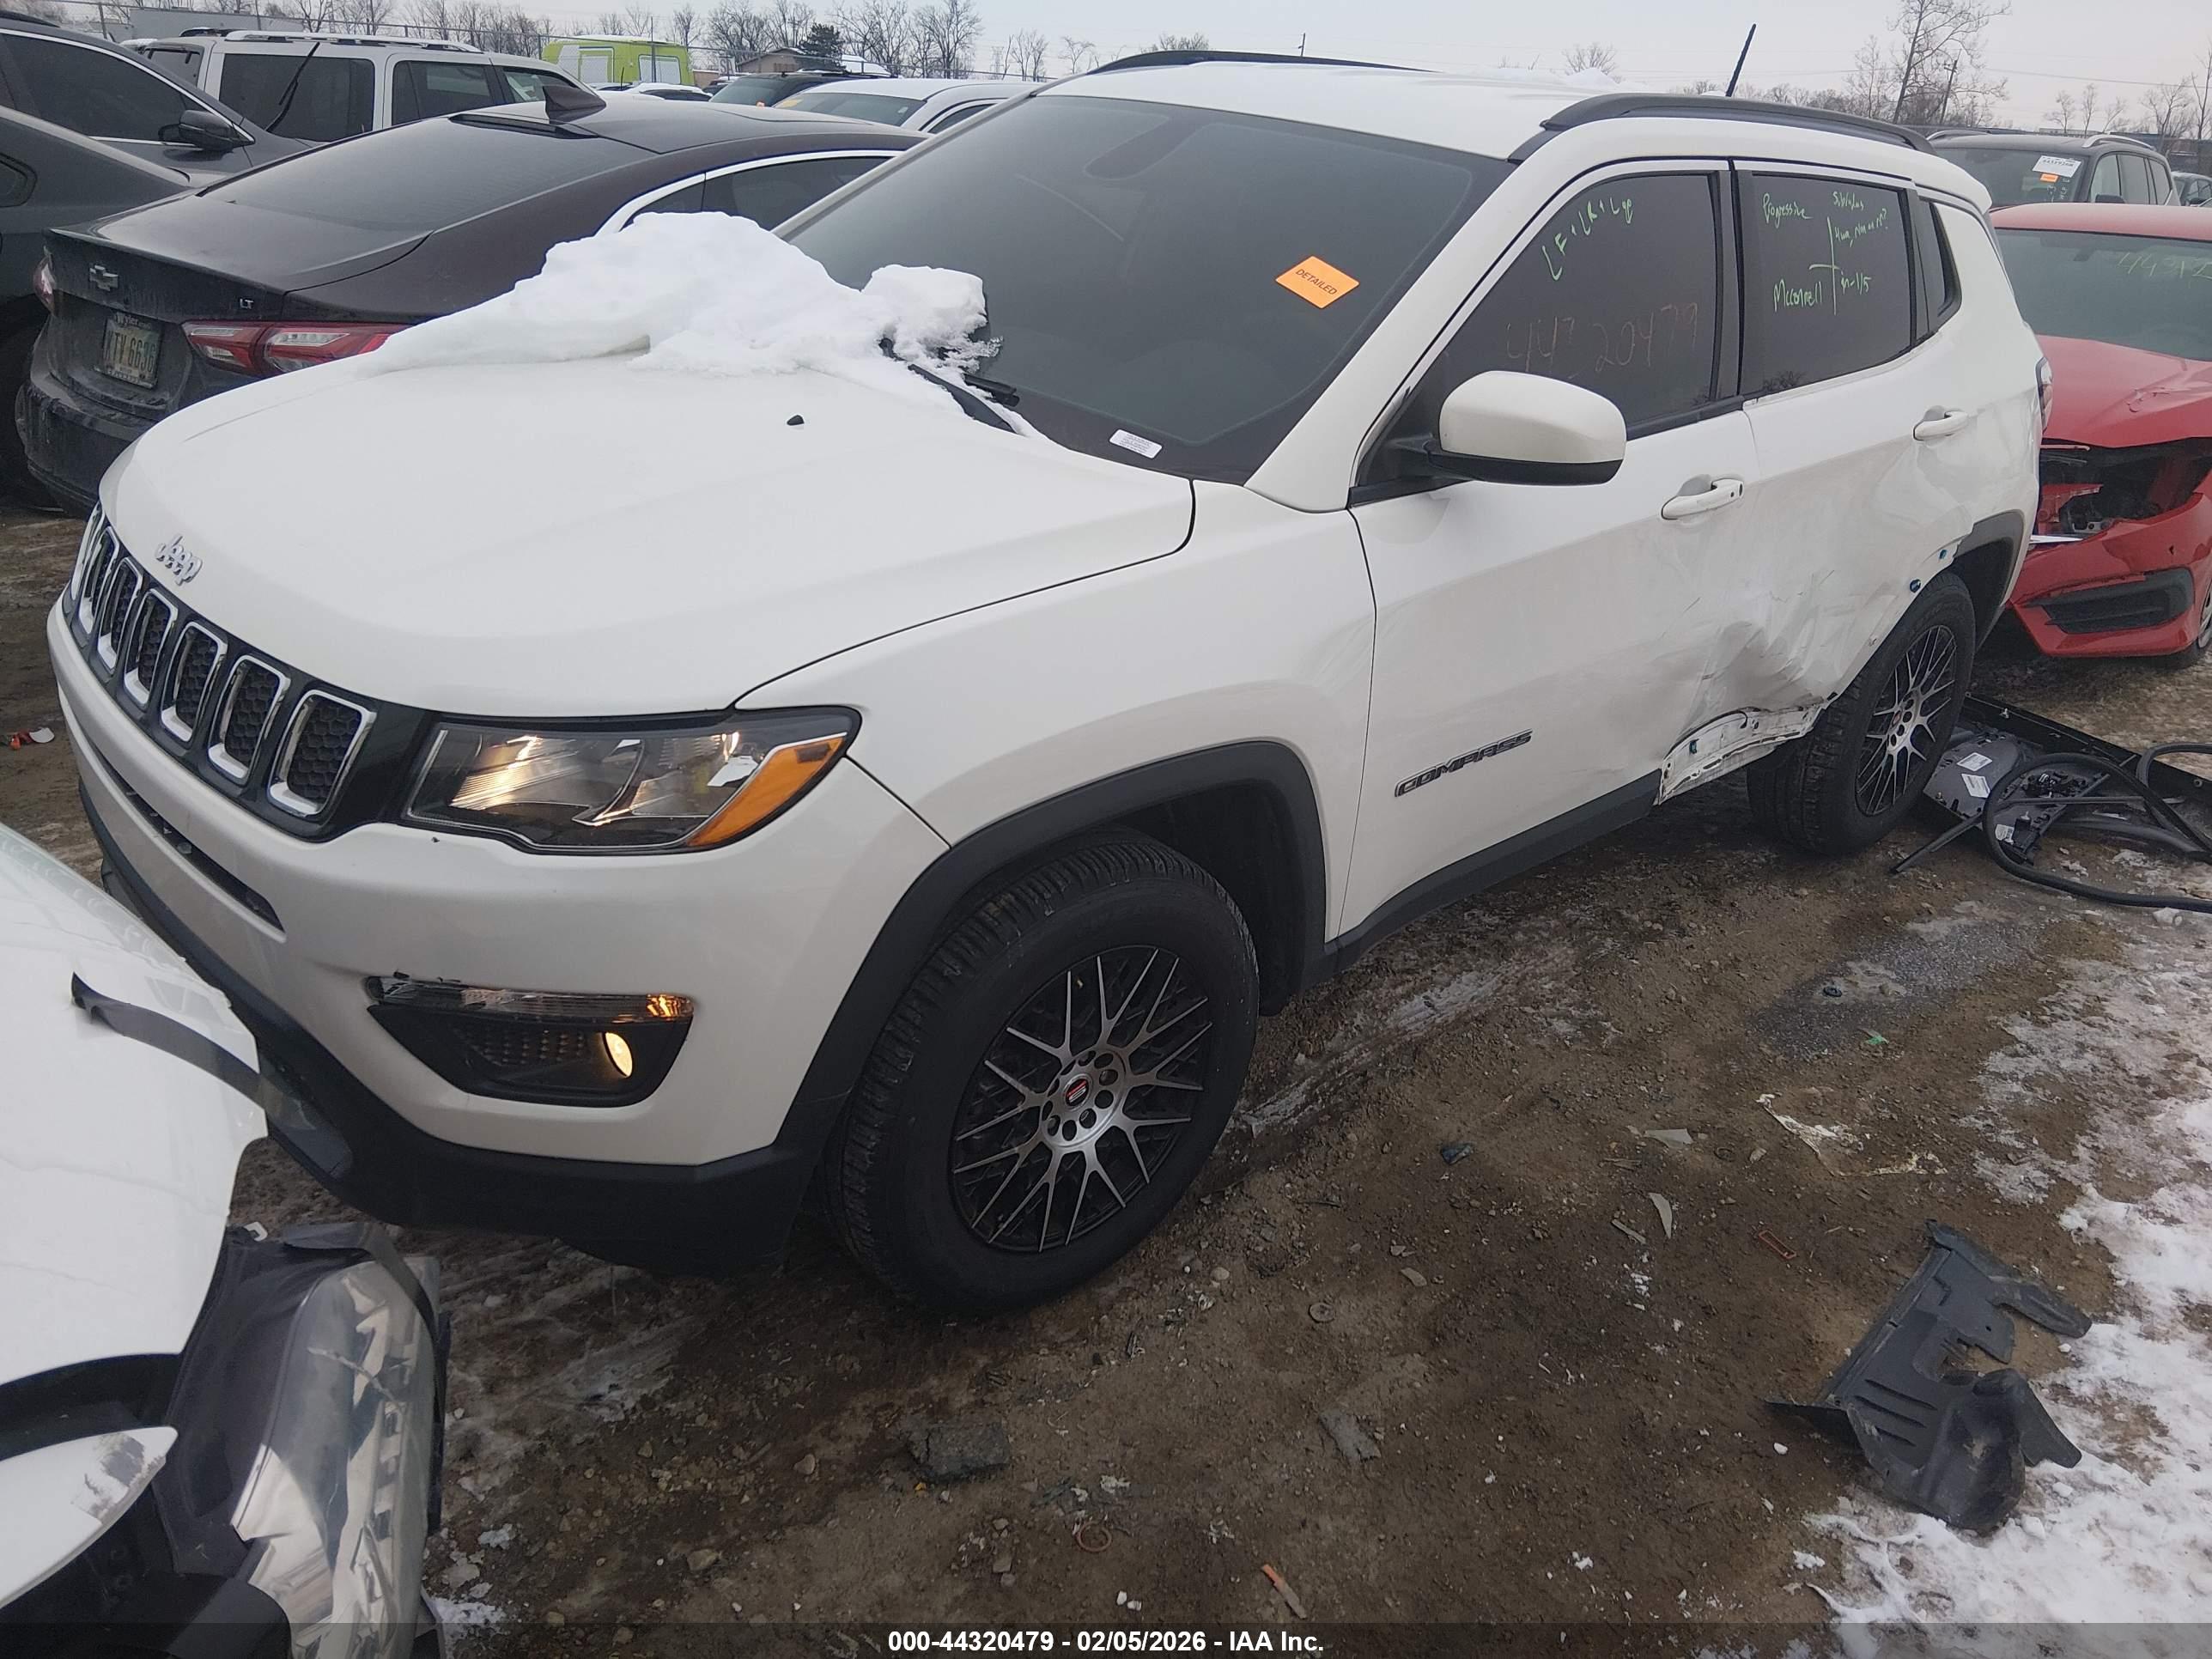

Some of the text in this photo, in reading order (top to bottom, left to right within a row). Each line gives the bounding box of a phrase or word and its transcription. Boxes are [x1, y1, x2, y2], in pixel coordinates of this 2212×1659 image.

[1295, 269, 1338, 295] DETAILED
[240, 298, 254, 309] LT
[155, 534, 203, 586] Jeep
[1395, 729, 1533, 797] COMPASS
